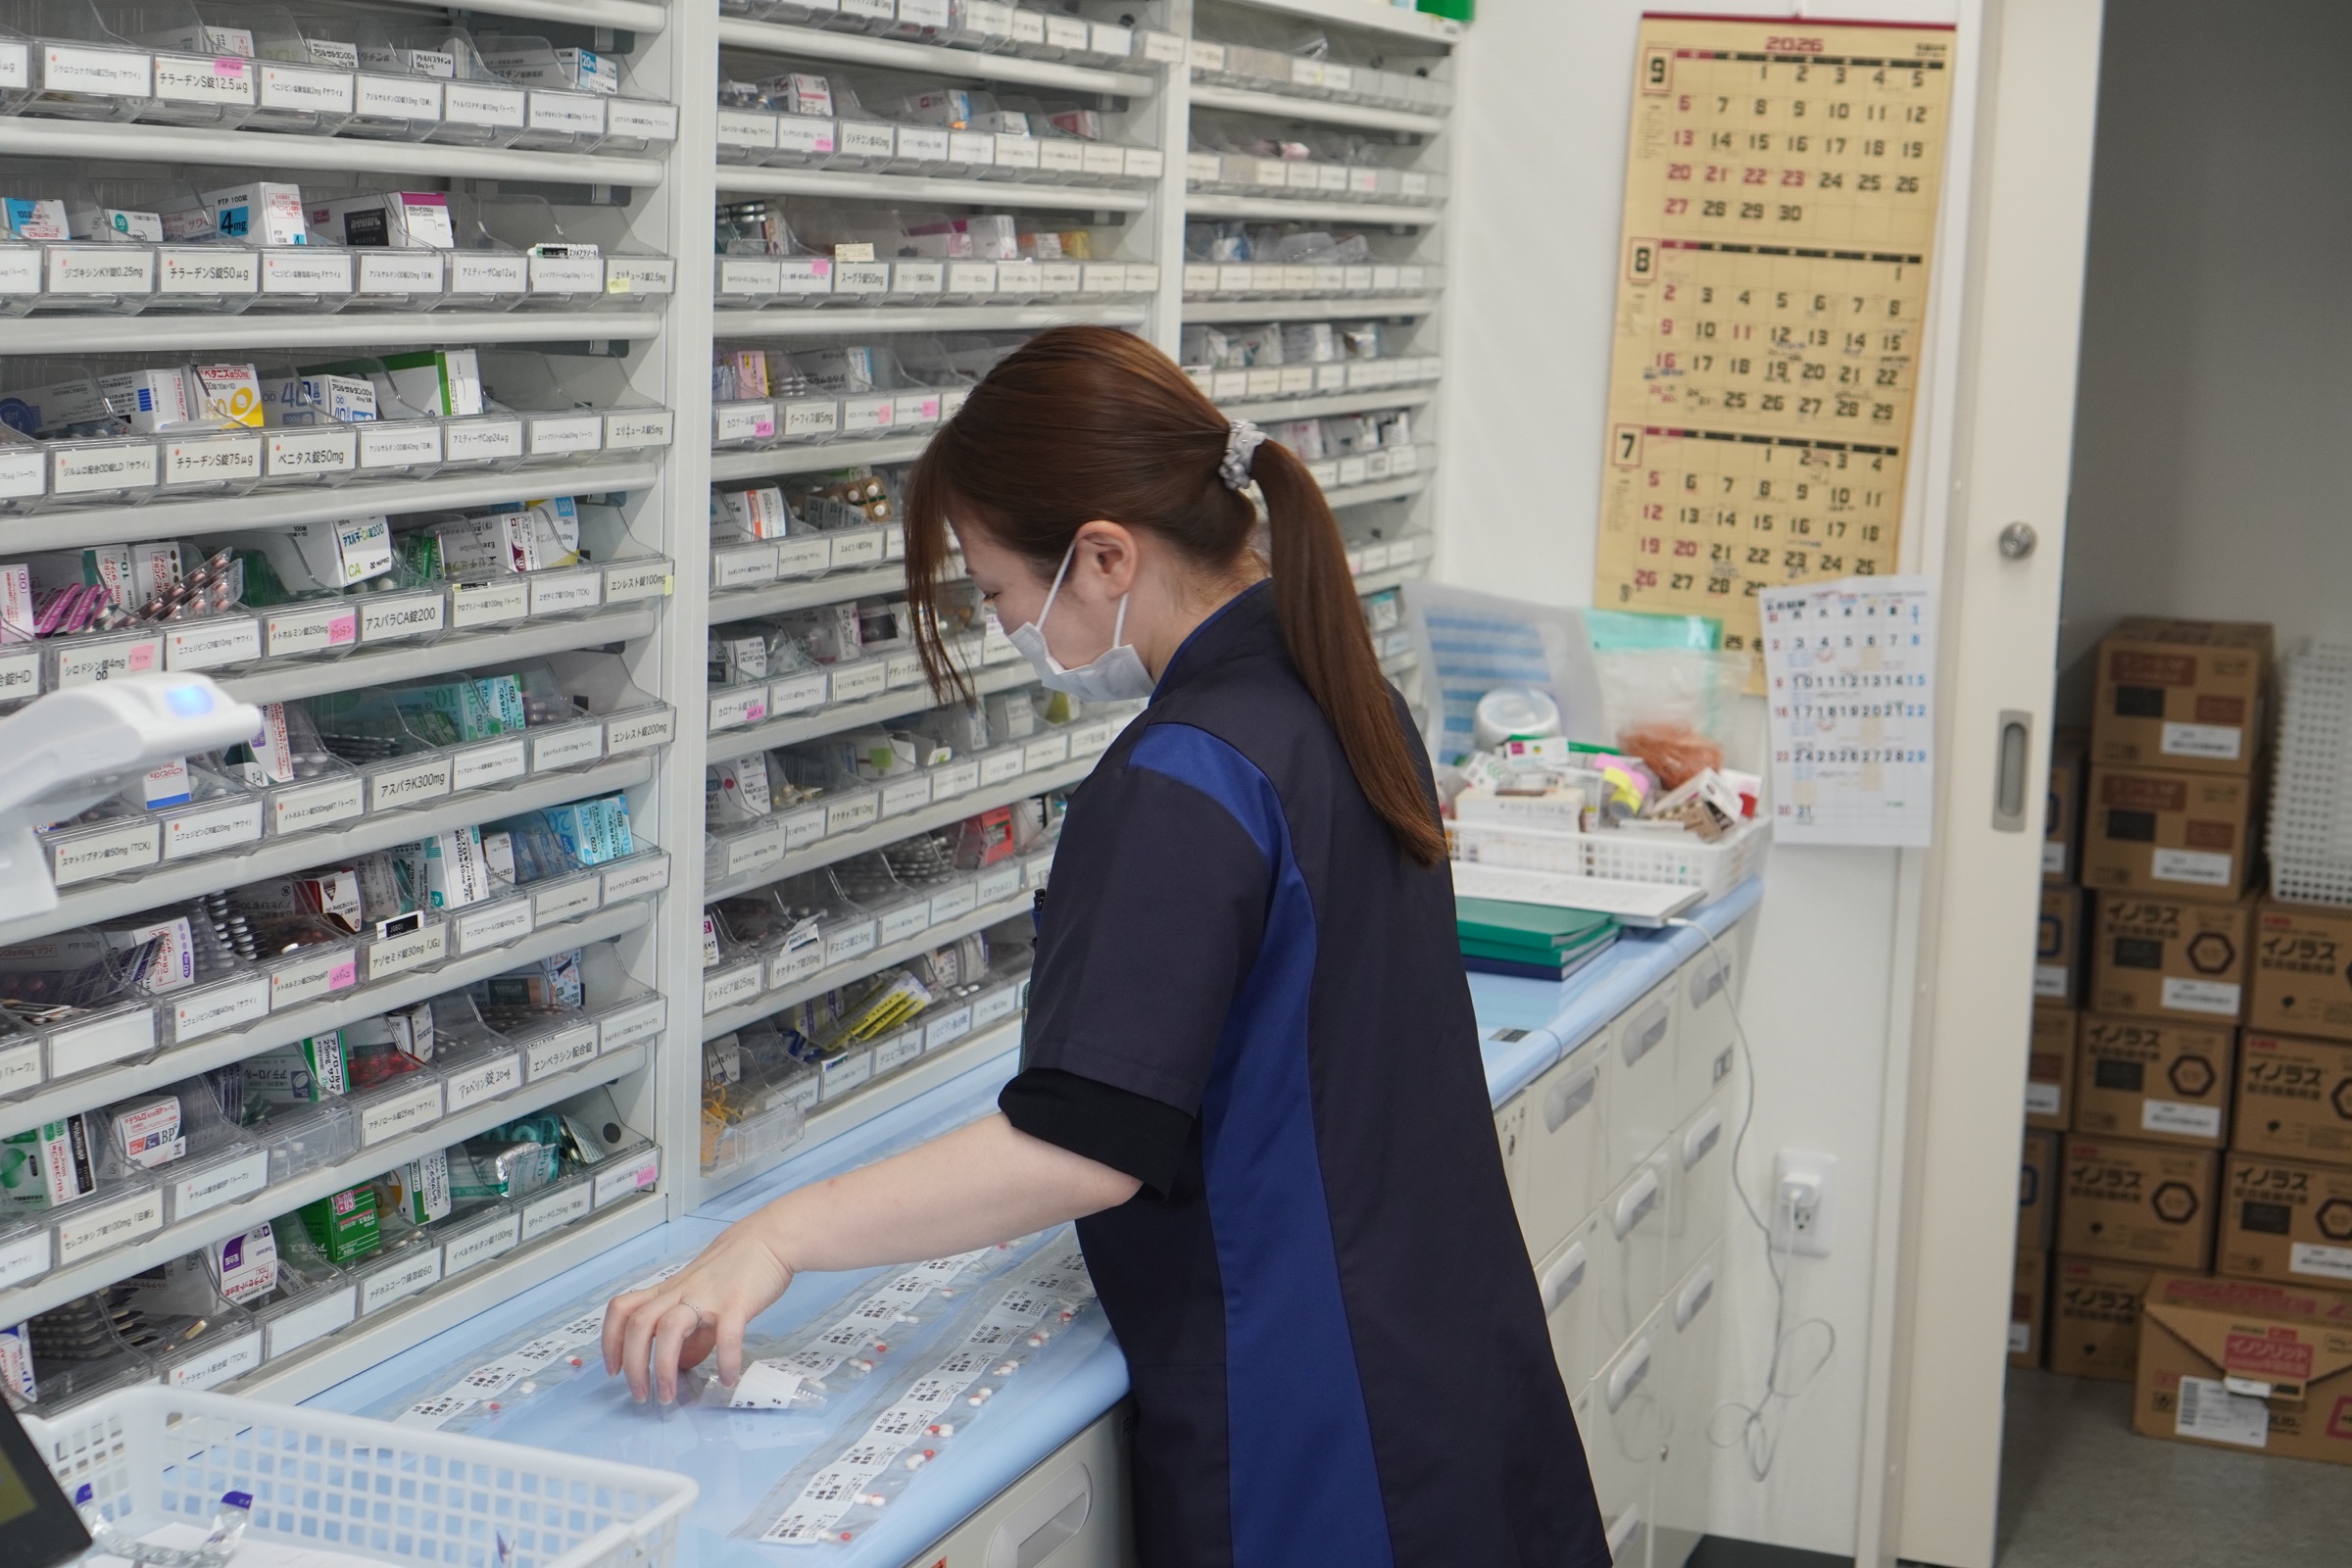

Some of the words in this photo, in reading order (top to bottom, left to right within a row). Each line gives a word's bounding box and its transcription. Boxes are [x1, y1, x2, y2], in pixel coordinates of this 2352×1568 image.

[1766, 37, 1823, 53] 2026
[1650, 58, 1664, 83] 9
[1761, 65, 1767, 79] 1
[1795, 67, 1808, 81] 2
[1835, 68, 1845, 83] 3
[1873, 70, 1885, 85] 4
[1911, 72, 1924, 87] 5
[160, 73, 248, 93] チラーヂンS錠12.5μg
[1679, 96, 1690, 112] 6
[1719, 97, 1729, 113] 7
[1755, 100, 1766, 116] 8
[1792, 101, 1805, 117] 9
[1829, 103, 1849, 119] 10
[1868, 105, 1886, 121] 11
[1906, 107, 1927, 122] 12
[1668, 164, 1691, 180] 20
[1705, 167, 1727, 182] 21
[1743, 169, 1766, 184] 22
[1782, 171, 1804, 187] 23
[1820, 172, 1842, 189] 24
[1858, 174, 1881, 191] 25
[1896, 177, 1919, 193] 26
[1665, 198, 1688, 215] 27
[1702, 201, 1726, 217] 28
[1740, 203, 1764, 220] 29
[1779, 205, 1801, 221] 30
[221, 212, 247, 234] 4mg
[1636, 248, 1649, 272] 8
[65, 267, 143, 279] ジゴキシンKY錠0.25mg
[170, 267, 249, 281] チラーヂンS錠50μg
[462, 268, 516, 278] アミティーザCap12μg
[1663, 285, 1676, 300] 2
[1701, 287, 1713, 303] 3
[1740, 290, 1750, 305] 4
[1777, 293, 1788, 309] 5
[1815, 295, 1826, 311] 6
[1853, 297, 1864, 313] 7
[1889, 300, 1899, 316] 8
[1655, 354, 1675, 368] 16
[1693, 356, 1713, 370] 17
[1731, 359, 1750, 373] 18
[1802, 365, 1825, 379] 20
[1839, 367, 1861, 382] 21
[1876, 369, 1897, 385] 22
[726, 415, 765, 428] カロナール錠200
[790, 413, 833, 425] グーフィス錠5mg
[454, 433, 509, 444] アミティーザCap24μg
[615, 423, 663, 439] エリキュース錠5mg
[1621, 434, 1635, 459] 7
[176, 454, 253, 469] チラーヂンS錠75μg
[1643, 505, 1662, 520] 12
[1680, 509, 1699, 523] 13
[1717, 512, 1736, 527] 14
[1754, 514, 1772, 530] 15
[1791, 518, 1810, 533] 16
[1828, 521, 1845, 537] 17
[1862, 525, 1879, 541] 18
[348, 564, 362, 577] CA
[1635, 570, 1657, 587] 26
[1671, 573, 1693, 589] 27
[1708, 577, 1730, 593] 28
[612, 574, 665, 592] エンレスト錠100mg
[367, 608, 435, 631] アスパラCA錠200
[272, 625, 328, 641] メトホルミン錠250mg
[718, 699, 759, 716] カロナール錠300
[613, 723, 667, 744] エンレスト錠200mg
[381, 773, 445, 798] アスパラK300mg
[830, 803, 874, 824] タケキャブ錠10mg
[62, 842, 151, 867] スマトリプタン錠50mg「TCK」
[2108, 903, 2180, 922] イノラス
[372, 941, 441, 968] アゾセミド錠30mg「JG」
[2262, 939, 2336, 958] イノラス
[775, 953, 821, 978] タケキャブ錠20mg
[708, 976, 756, 1001] ジャヌビア錠25mg
[2088, 1025, 2160, 1046] イノラス
[534, 1042, 593, 1072] エンペラシン配合錠
[2248, 1062, 2321, 1085] イノラス
[368, 1101, 435, 1131] アテノロール錠25mg「サワイ」
[161, 1128, 175, 1145] BP
[2070, 1166, 2141, 1188] イノラス
[2235, 1167, 2308, 1190] イノラス
[63, 1210, 155, 1250] セレコキシブ錠100mg「日新」
[2065, 1290, 2135, 1310] イノラス
